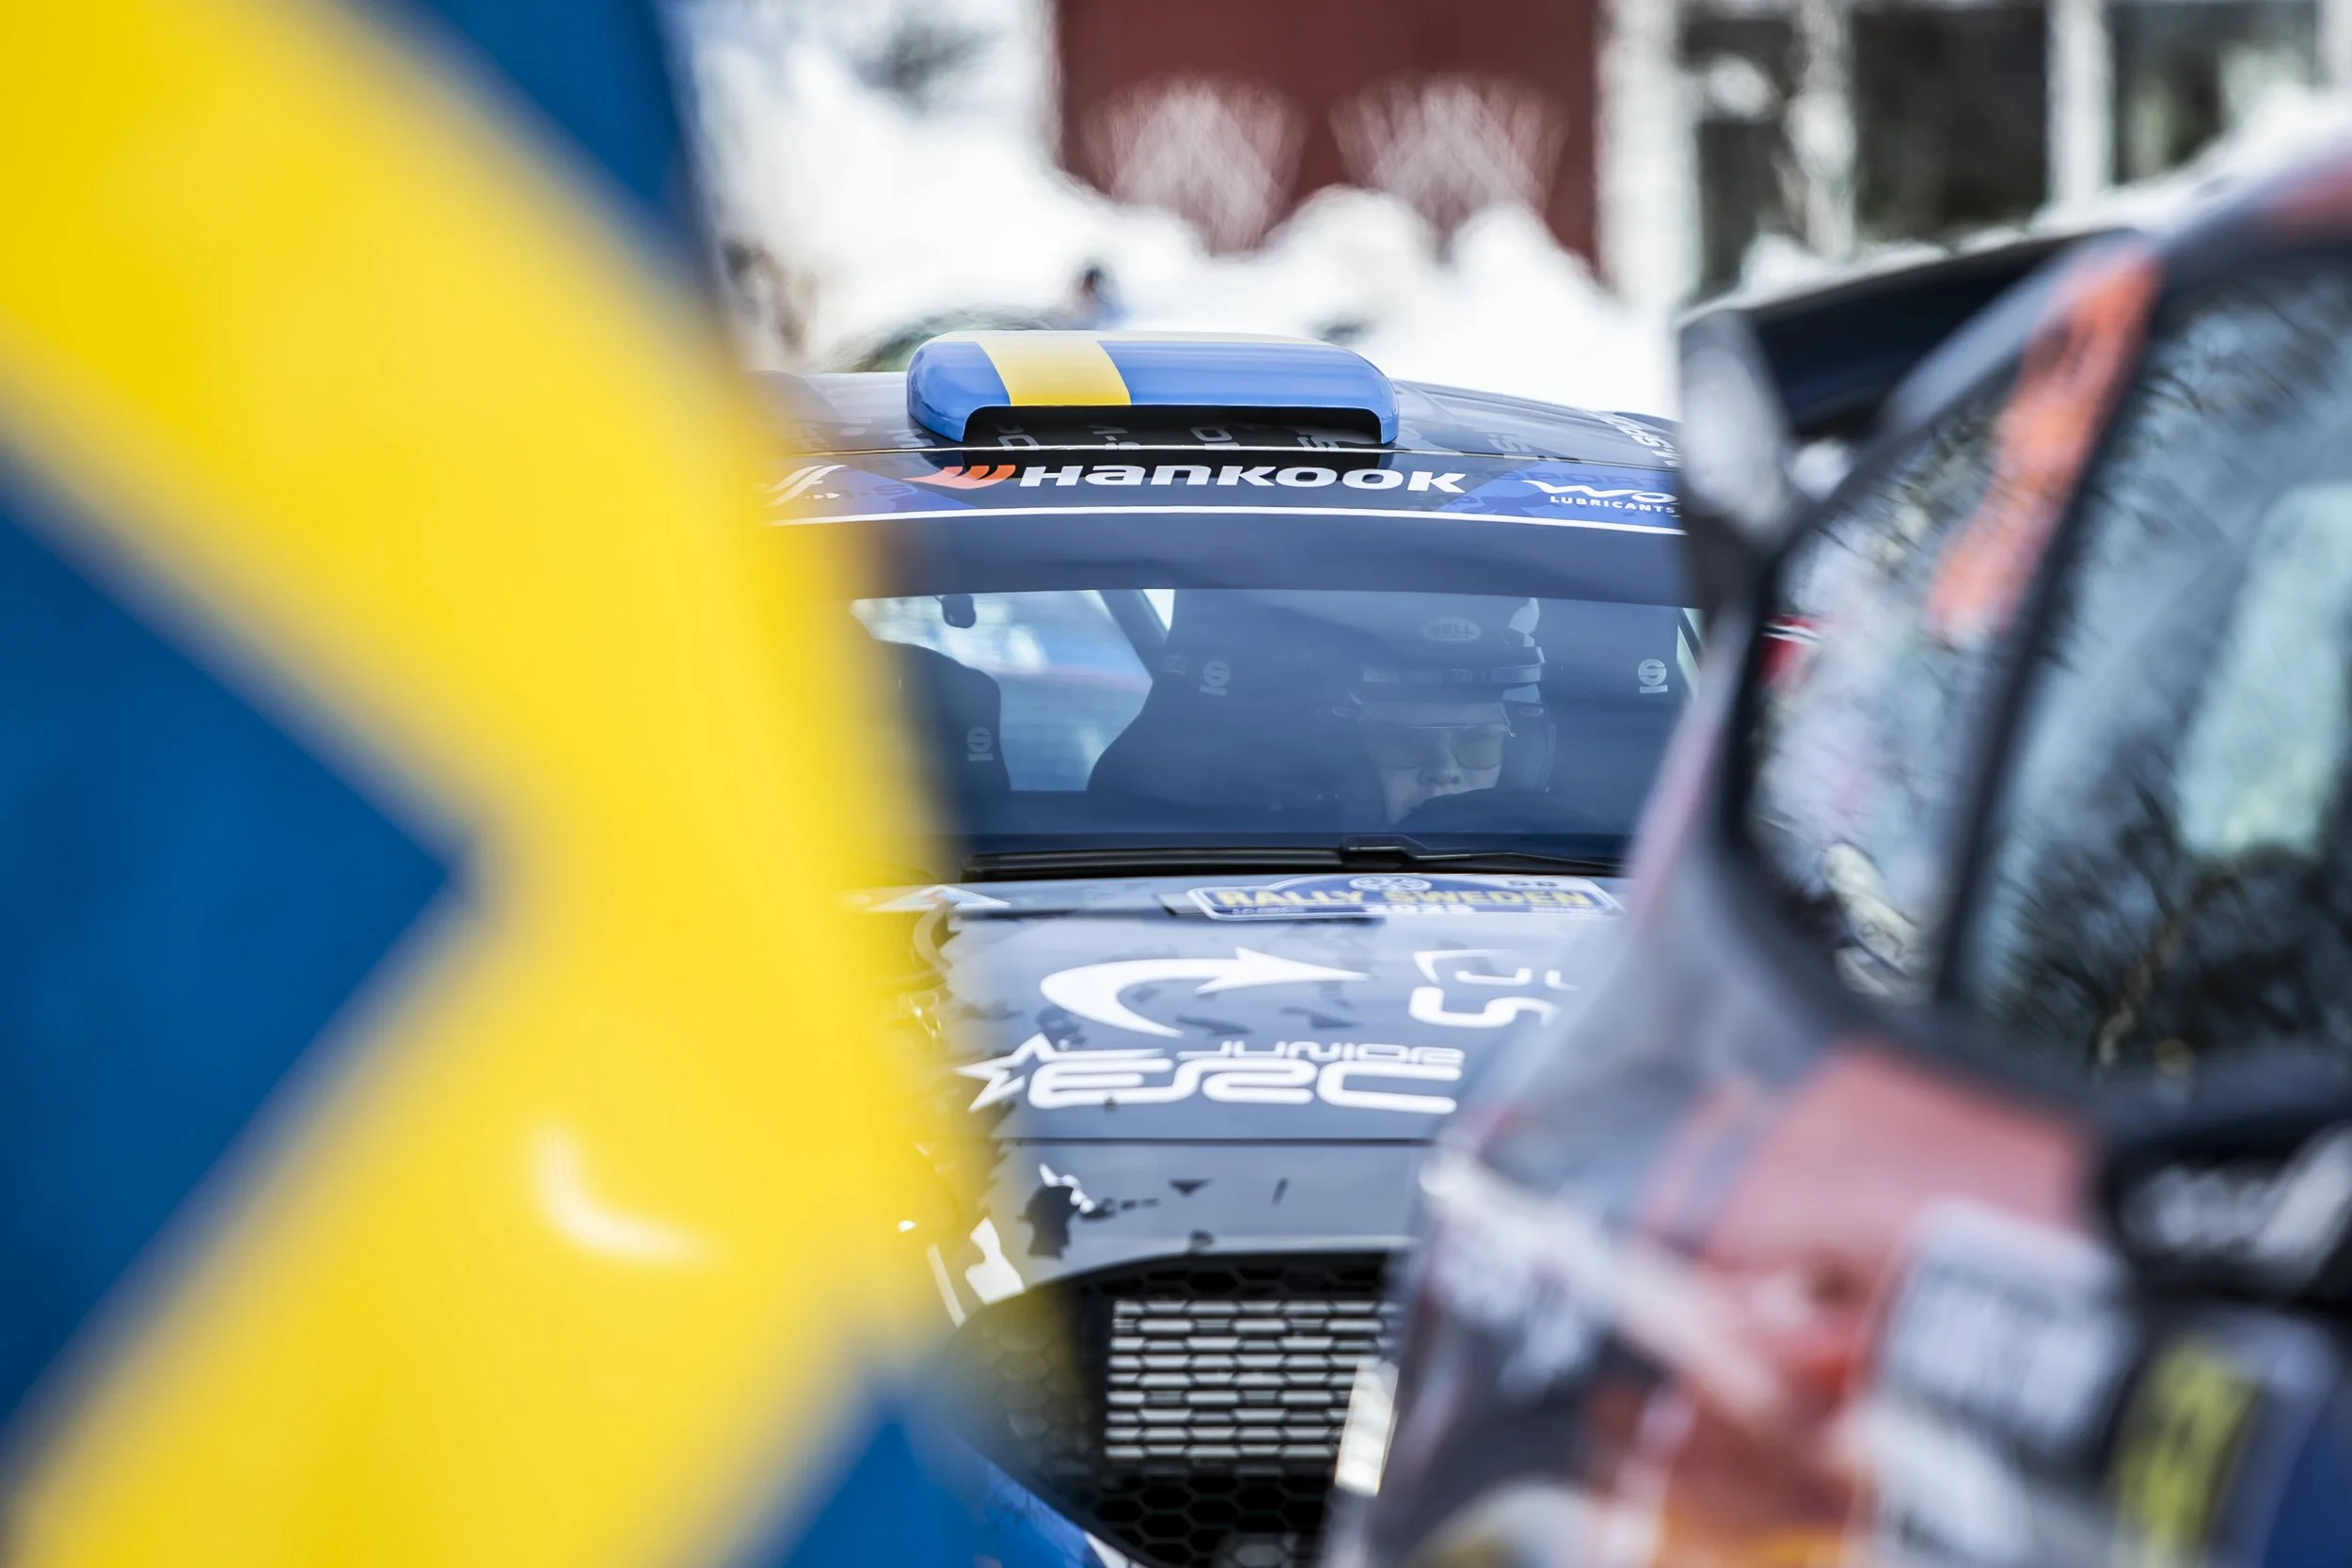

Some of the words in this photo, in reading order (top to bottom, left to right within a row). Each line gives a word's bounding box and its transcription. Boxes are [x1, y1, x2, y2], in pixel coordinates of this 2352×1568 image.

[1521, 480, 1680, 504] WO
[1549, 495, 1676, 514] LUBRICANTS
[1216, 890, 1363, 907] RALLY
[1384, 890, 1593, 907] SWEDEN
[1176, 1040, 1467, 1066] JUNIOR
